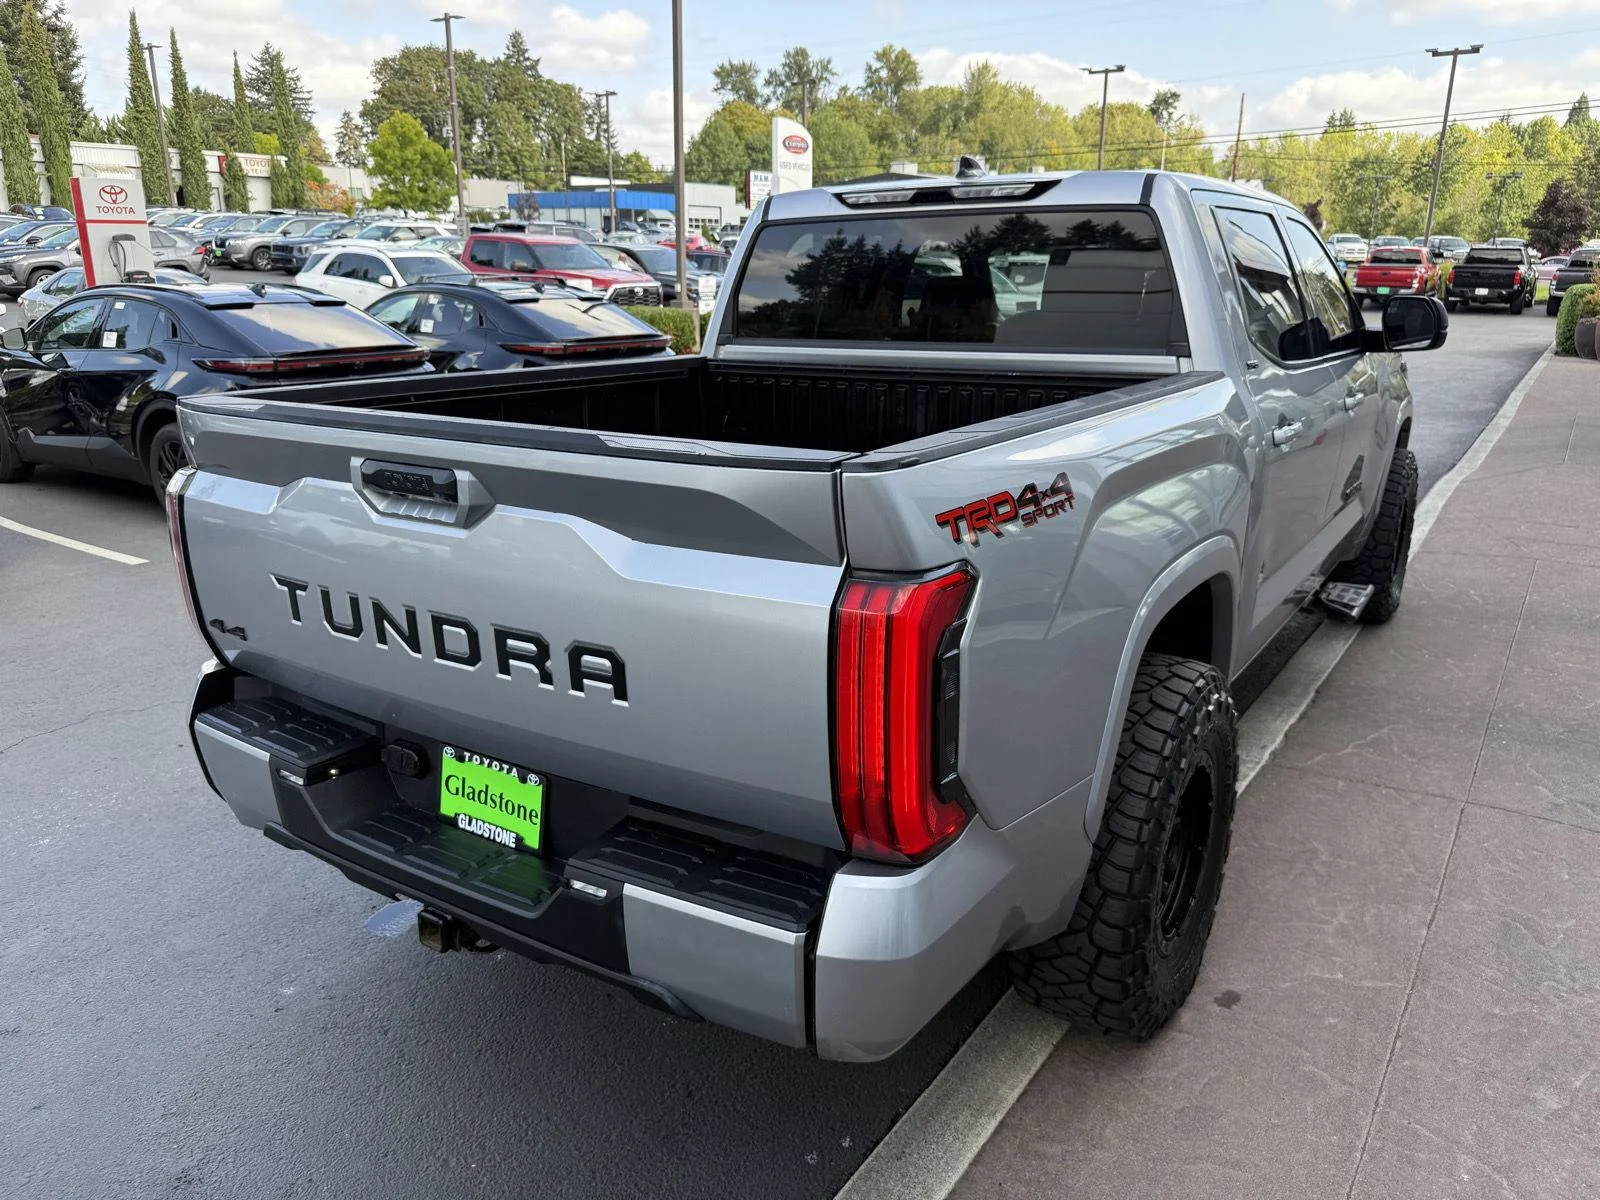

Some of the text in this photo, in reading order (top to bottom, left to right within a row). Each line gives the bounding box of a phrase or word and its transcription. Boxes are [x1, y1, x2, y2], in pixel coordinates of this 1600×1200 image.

[245, 158, 271, 168] TOYOT
[96, 205, 136, 214] TOYOTA
[384, 471, 430, 491] TOYOTA
[935, 490, 1018, 548] TRD
[1021, 494, 1076, 528] SPORT
[269, 571, 630, 708] TUNDRA
[464, 751, 519, 778] TOYOTA
[444, 774, 539, 826] Gladstone
[457, 813, 517, 849] GLADSTONE
